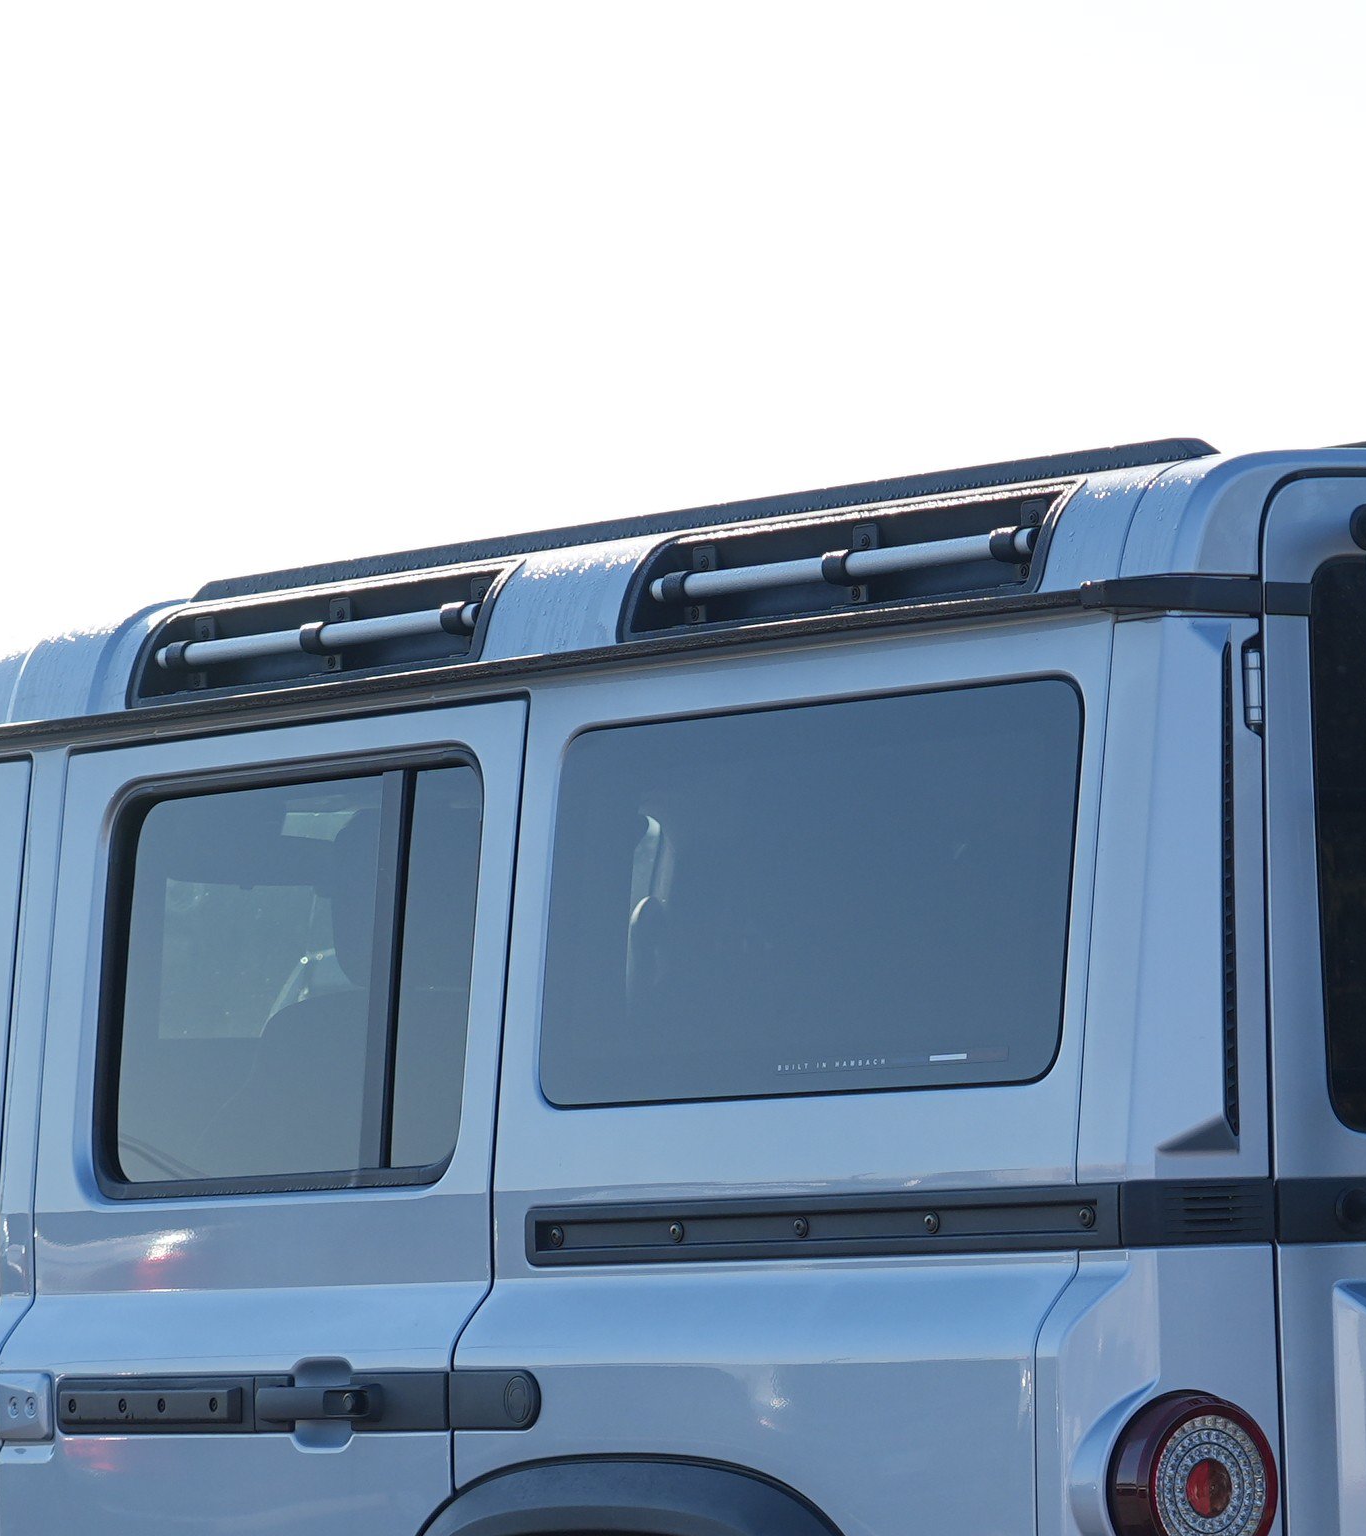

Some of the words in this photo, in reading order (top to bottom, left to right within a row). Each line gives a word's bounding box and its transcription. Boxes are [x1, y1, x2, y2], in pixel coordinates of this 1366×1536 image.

[777, 1062, 809, 1072] BUILT
[816, 1061, 828, 1069] IN
[834, 1058, 887, 1068] HAMBACH
